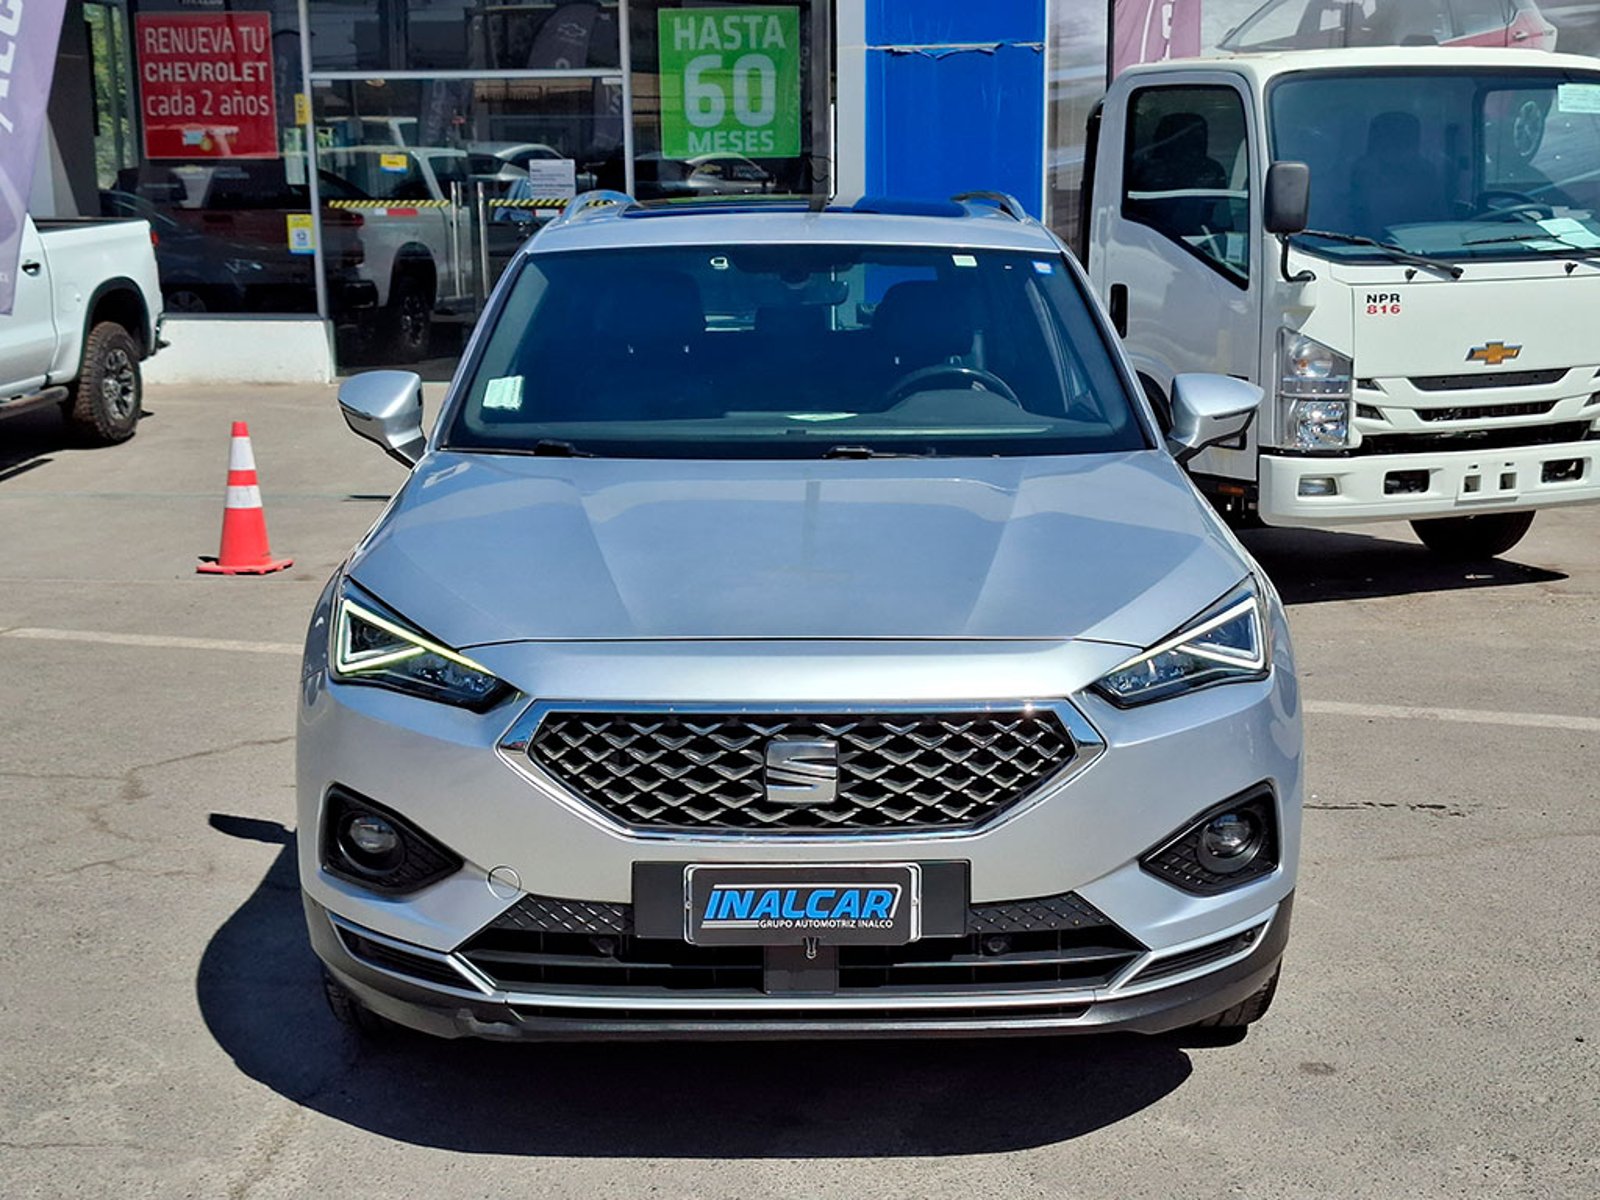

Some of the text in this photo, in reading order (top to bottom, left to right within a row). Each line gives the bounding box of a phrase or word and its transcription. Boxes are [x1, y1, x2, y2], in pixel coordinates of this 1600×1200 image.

[145, 26, 266, 54] RENUEVA TU
[674, 14, 786, 51] HASTA
[144, 61, 268, 82] CHEVROLET
[146, 89, 196, 117] cada
[201, 89, 214, 116] 2
[219, 89, 270, 116] años
[684, 53, 776, 128] 60
[687, 129, 774, 153] MESES
[1366, 293, 1401, 303] NPR
[1366, 303, 1401, 315] 816
[704, 889, 894, 920] INALCAR
[759, 919, 894, 929] GRUPO AUTOMOTRIZ INALCO
